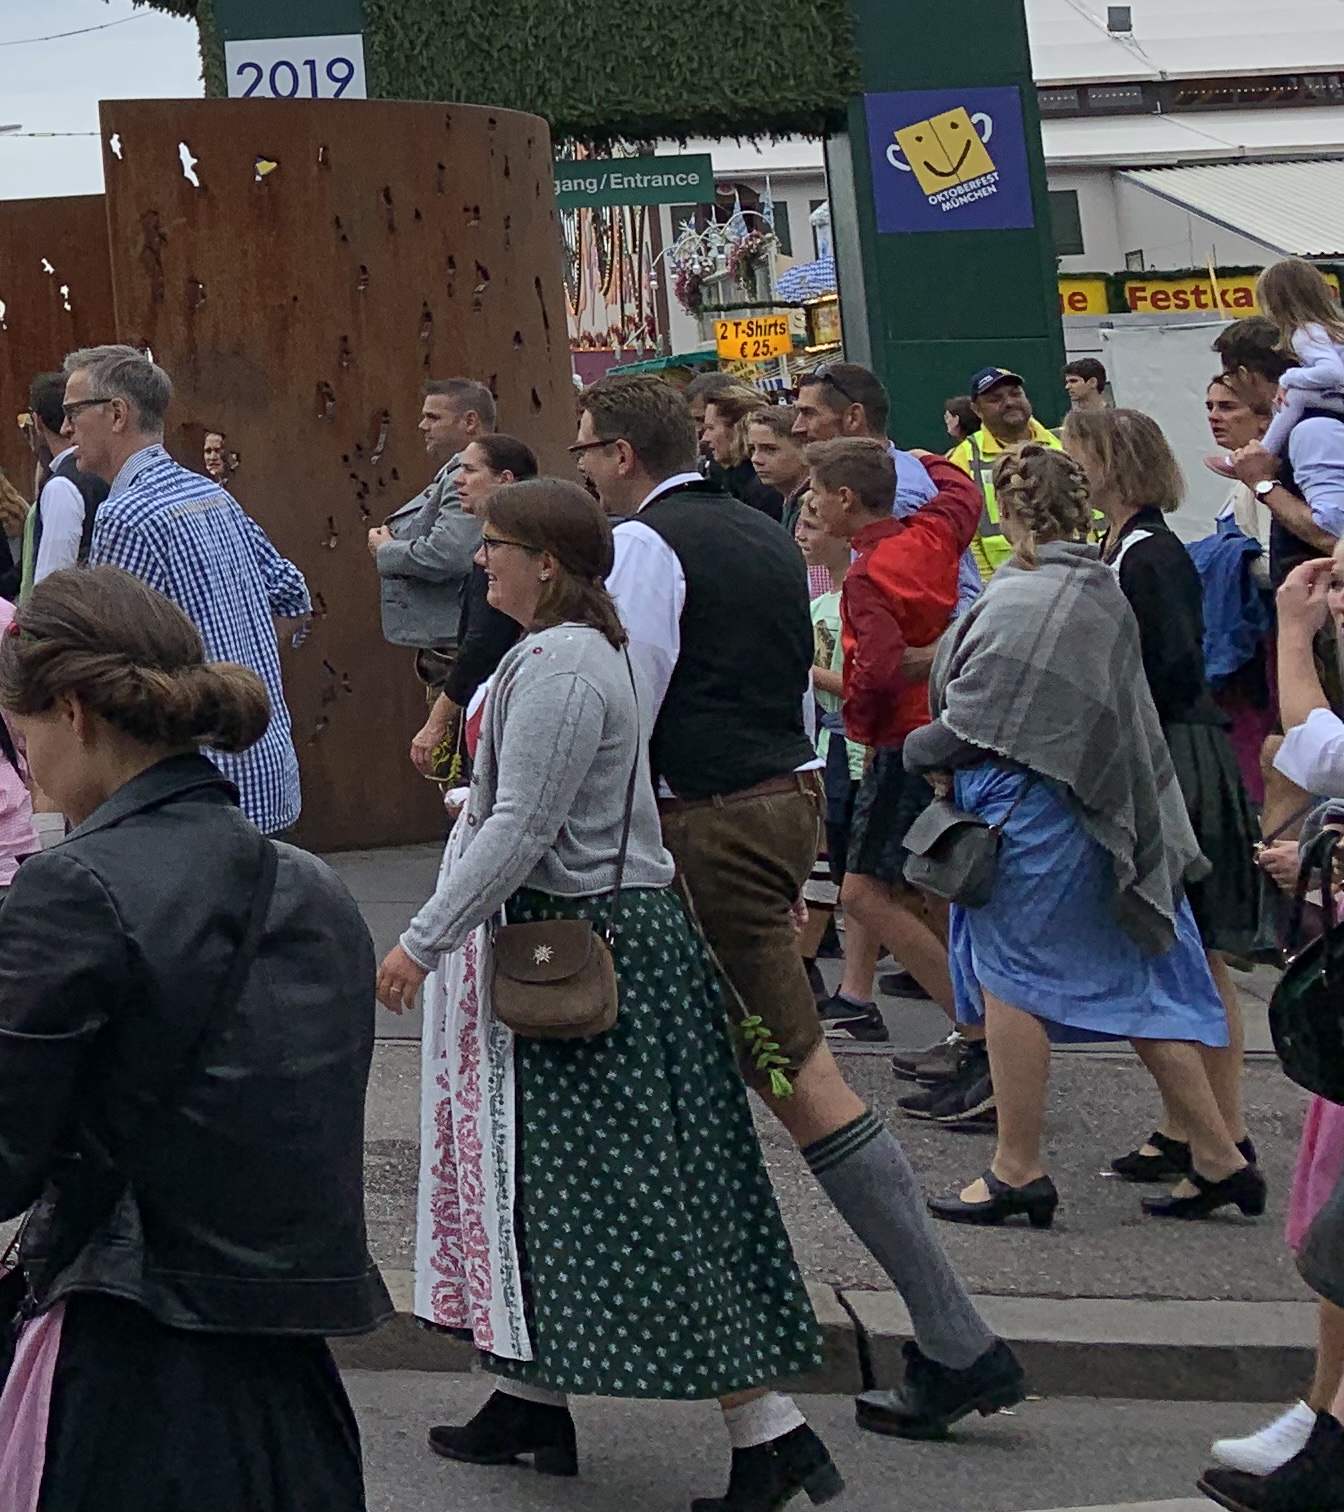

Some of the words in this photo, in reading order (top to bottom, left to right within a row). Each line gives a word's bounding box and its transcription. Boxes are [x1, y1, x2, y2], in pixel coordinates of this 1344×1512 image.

[236, 57, 355, 98] 2019
[928, 172, 1000, 205] OKTOBERFEST
[941, 184, 998, 212] MÜNCHEN
[1128, 283, 1255, 311] Festka
[720, 323, 729, 340] 2
[733, 319, 787, 339] T-Shirts
[740, 341, 749, 358] €
